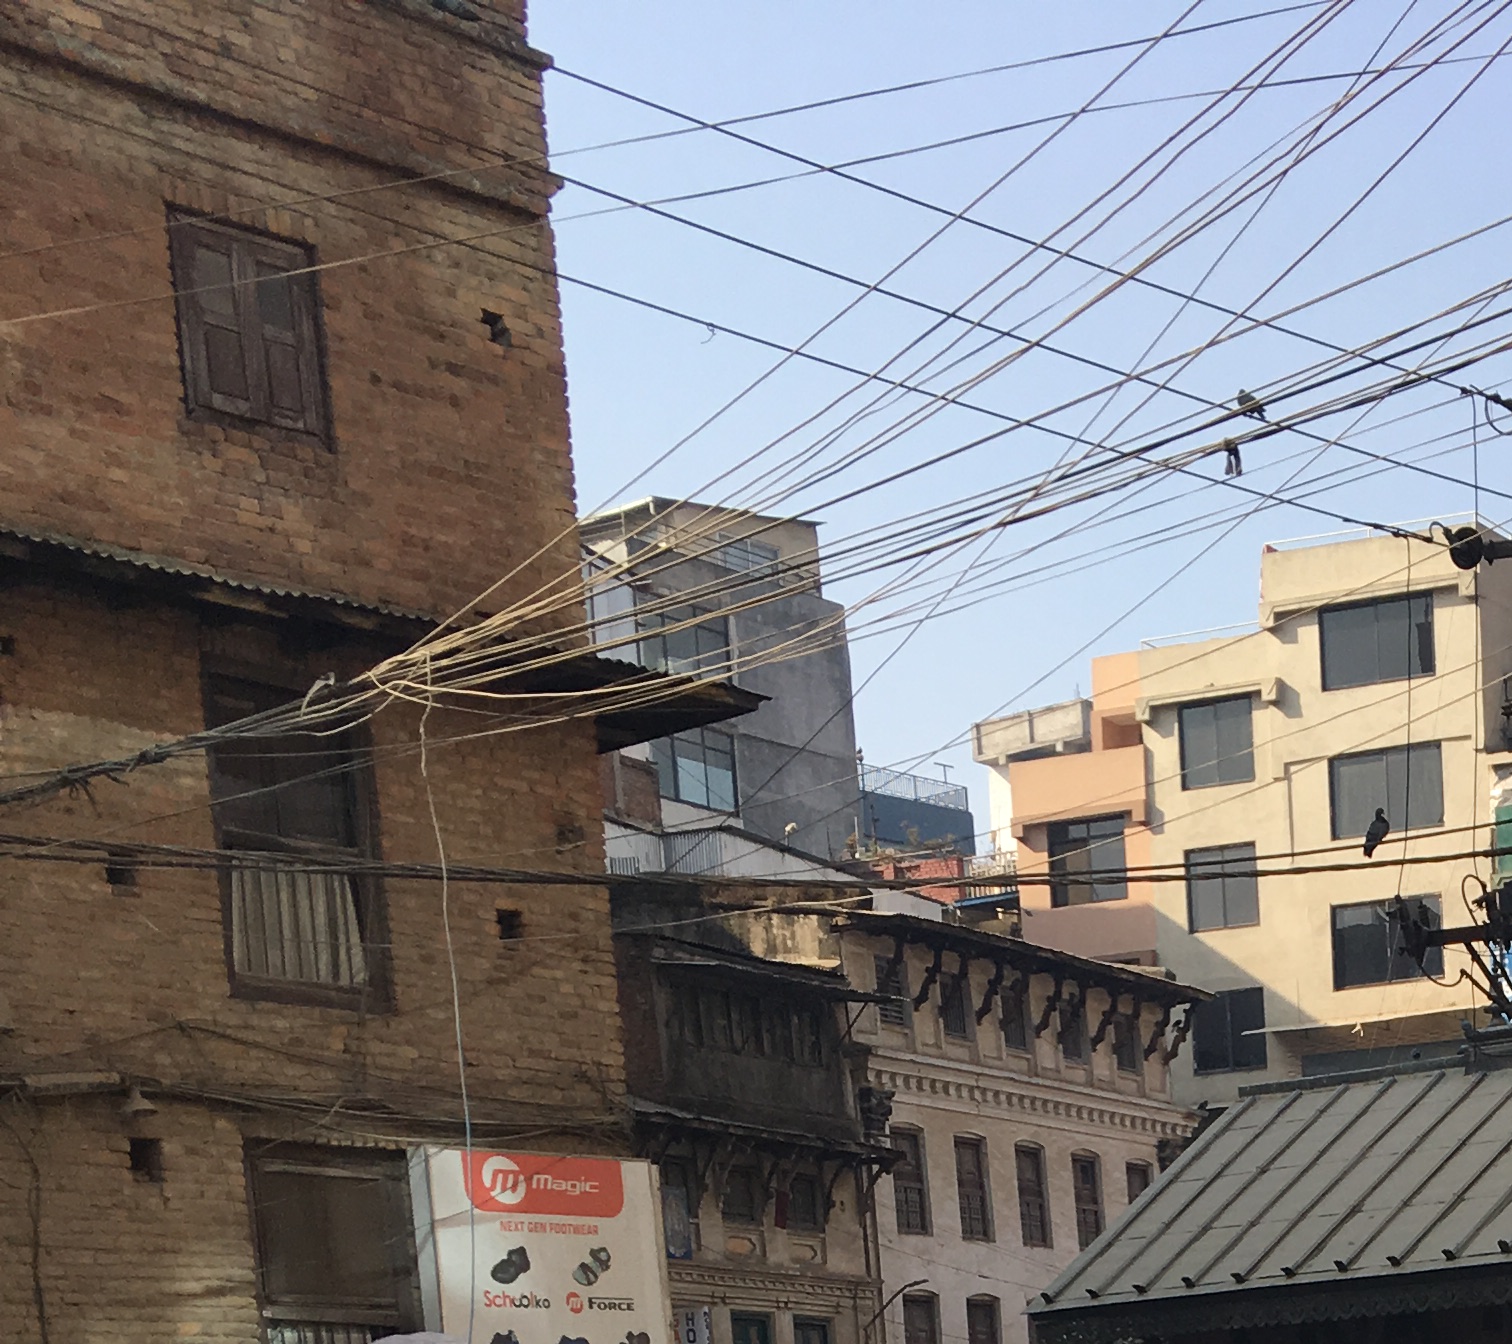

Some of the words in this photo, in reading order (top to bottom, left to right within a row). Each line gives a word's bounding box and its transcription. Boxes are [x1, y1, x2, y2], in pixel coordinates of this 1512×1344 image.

[532, 1173, 600, 1195] Magic
[500, 1219, 524, 1233] NEXT
[587, 1296, 635, 1312] FORCE
